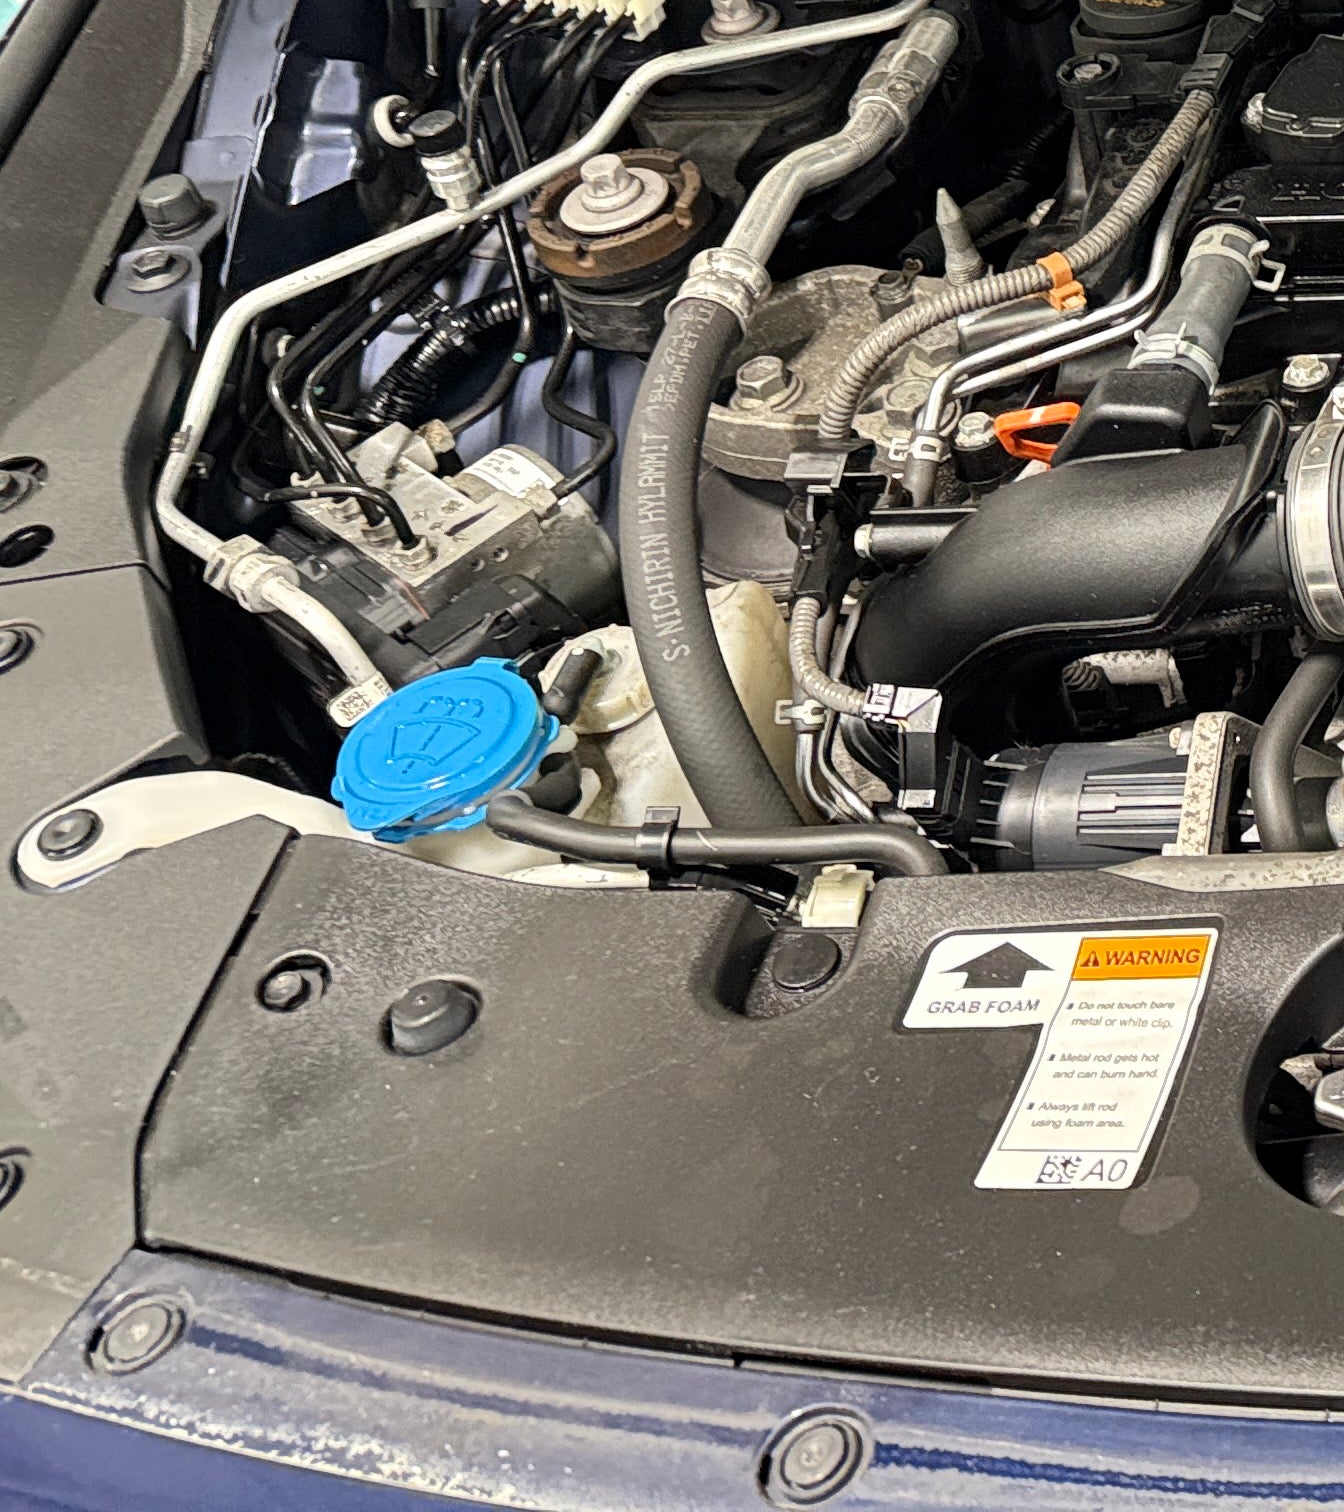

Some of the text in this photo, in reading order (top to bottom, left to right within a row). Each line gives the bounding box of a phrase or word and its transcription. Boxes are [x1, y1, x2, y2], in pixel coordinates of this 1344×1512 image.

[1106, 948, 1200, 966] WARNING
[927, 999, 1040, 1014] GRAB FOAM
[1078, 1001, 1175, 1010] Do not touch bare
[1071, 1016, 1173, 1030] metal or white clip.
[1059, 1053, 1160, 1064] Metal rod gets hot
[1052, 1070, 1075, 1078] and
[1100, 1070, 1126, 1078] burn
[1128, 1069, 1158, 1078] hand.
[1038, 1102, 1118, 1113] Always lift rod
[1031, 1119, 1061, 1129] using
[1064, 1118, 1094, 1127] foam
[1080, 1158, 1129, 1182] A0
